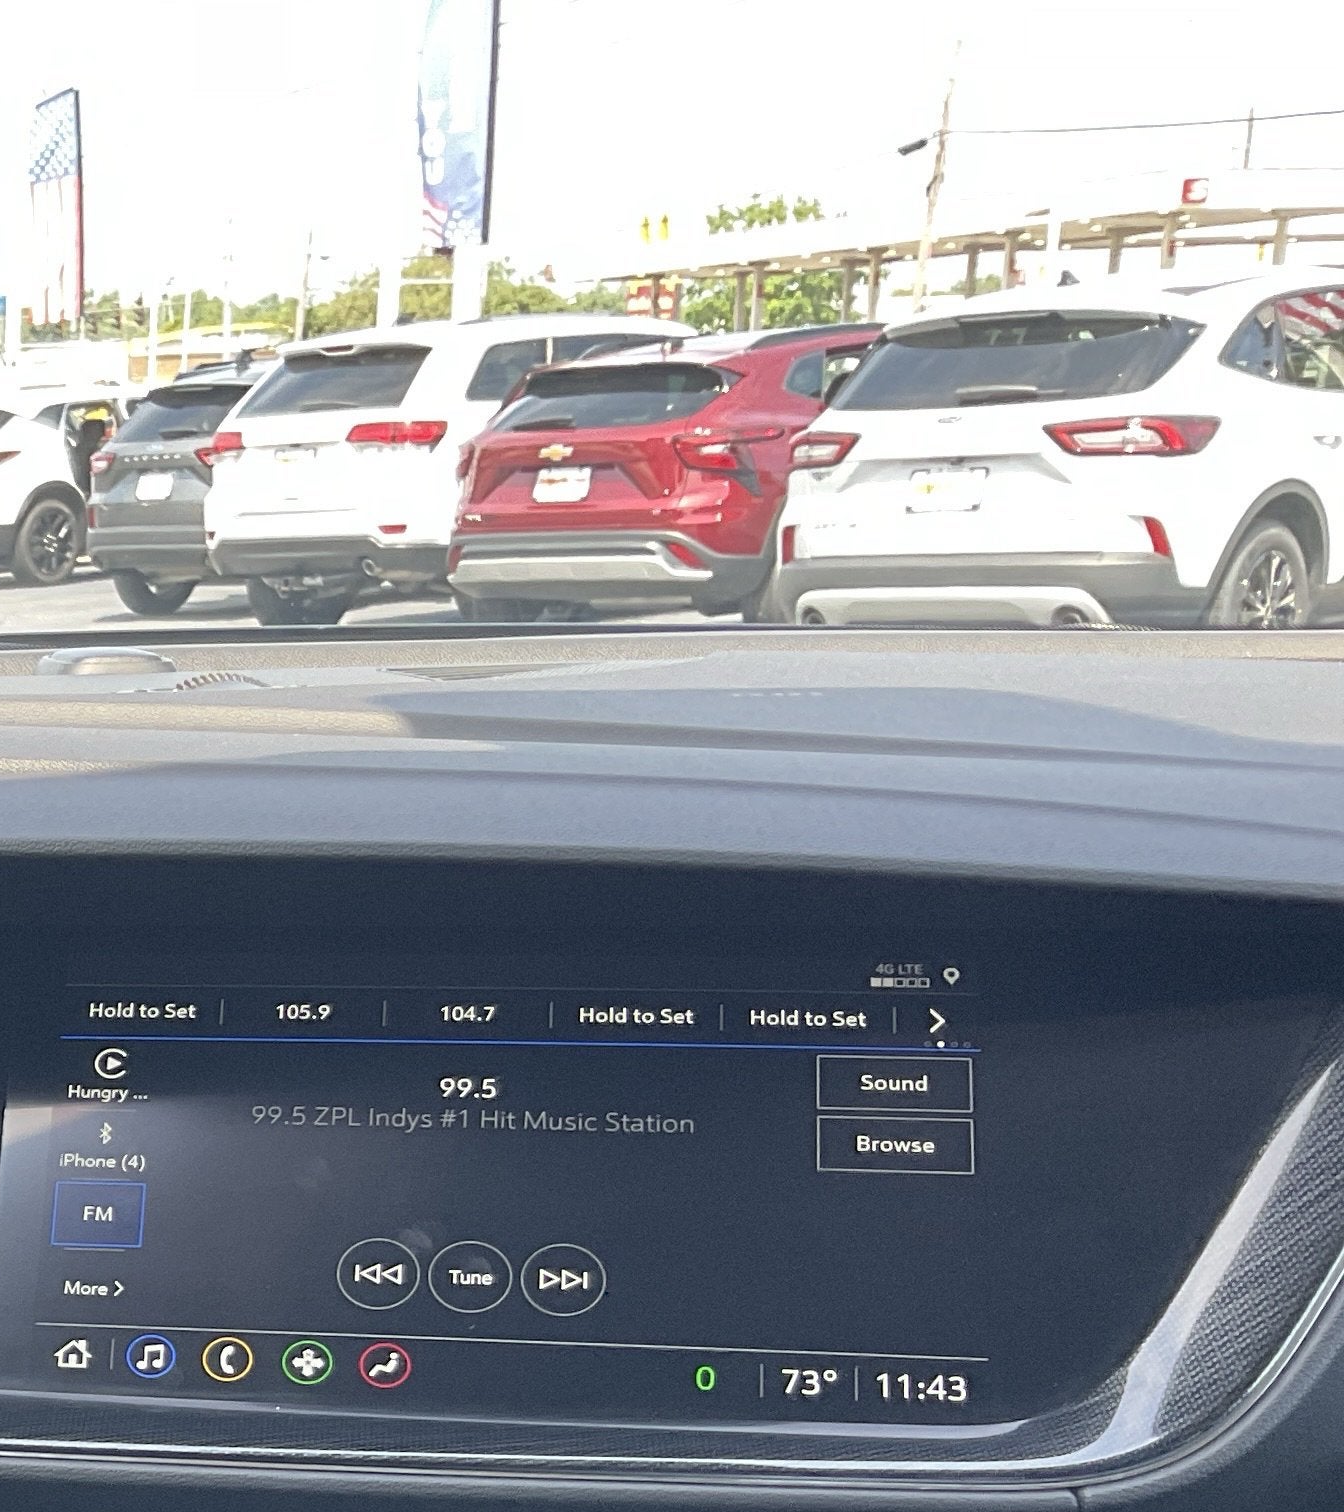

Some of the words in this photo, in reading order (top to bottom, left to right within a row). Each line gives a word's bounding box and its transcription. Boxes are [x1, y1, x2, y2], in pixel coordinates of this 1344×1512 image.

[875, 963, 894, 976] 4G
[898, 963, 924, 976] LTE
[88, 1002, 134, 1020] Hold
[138, 1004, 159, 1020] to
[163, 1003, 196, 1020] Set
[275, 1004, 331, 1021] 105.9
[440, 1005, 495, 1023] 104.7
[579, 1007, 627, 1025] Hold
[632, 1009, 655, 1025] to
[659, 1008, 694, 1026] Set
[750, 1009, 799, 1027] Hold
[804, 1012, 827, 1028] to
[831, 1011, 867, 1029] Set
[438, 1077, 498, 1099] 99.5
[860, 1074, 929, 1093] Sound
[67, 1084, 129, 1103] Hungry
[251, 1105, 307, 1126] 99.5
[313, 1106, 361, 1127] ZPL
[368, 1107, 433, 1132] Indys
[439, 1109, 471, 1129] #1
[480, 1110, 516, 1130] Hit
[523, 1111, 598, 1132] Music
[604, 1113, 695, 1134] Station
[855, 1136, 935, 1154] Browse
[59, 1153, 117, 1169] iPhone
[121, 1154, 146, 1172] (4)
[83, 1205, 113, 1222] FM
[449, 1269, 493, 1286] Tune
[63, 1280, 109, 1296] More
[695, 1366, 716, 1391] 0
[781, 1368, 838, 1396] 73°
[876, 1372, 968, 1402] 11:43
